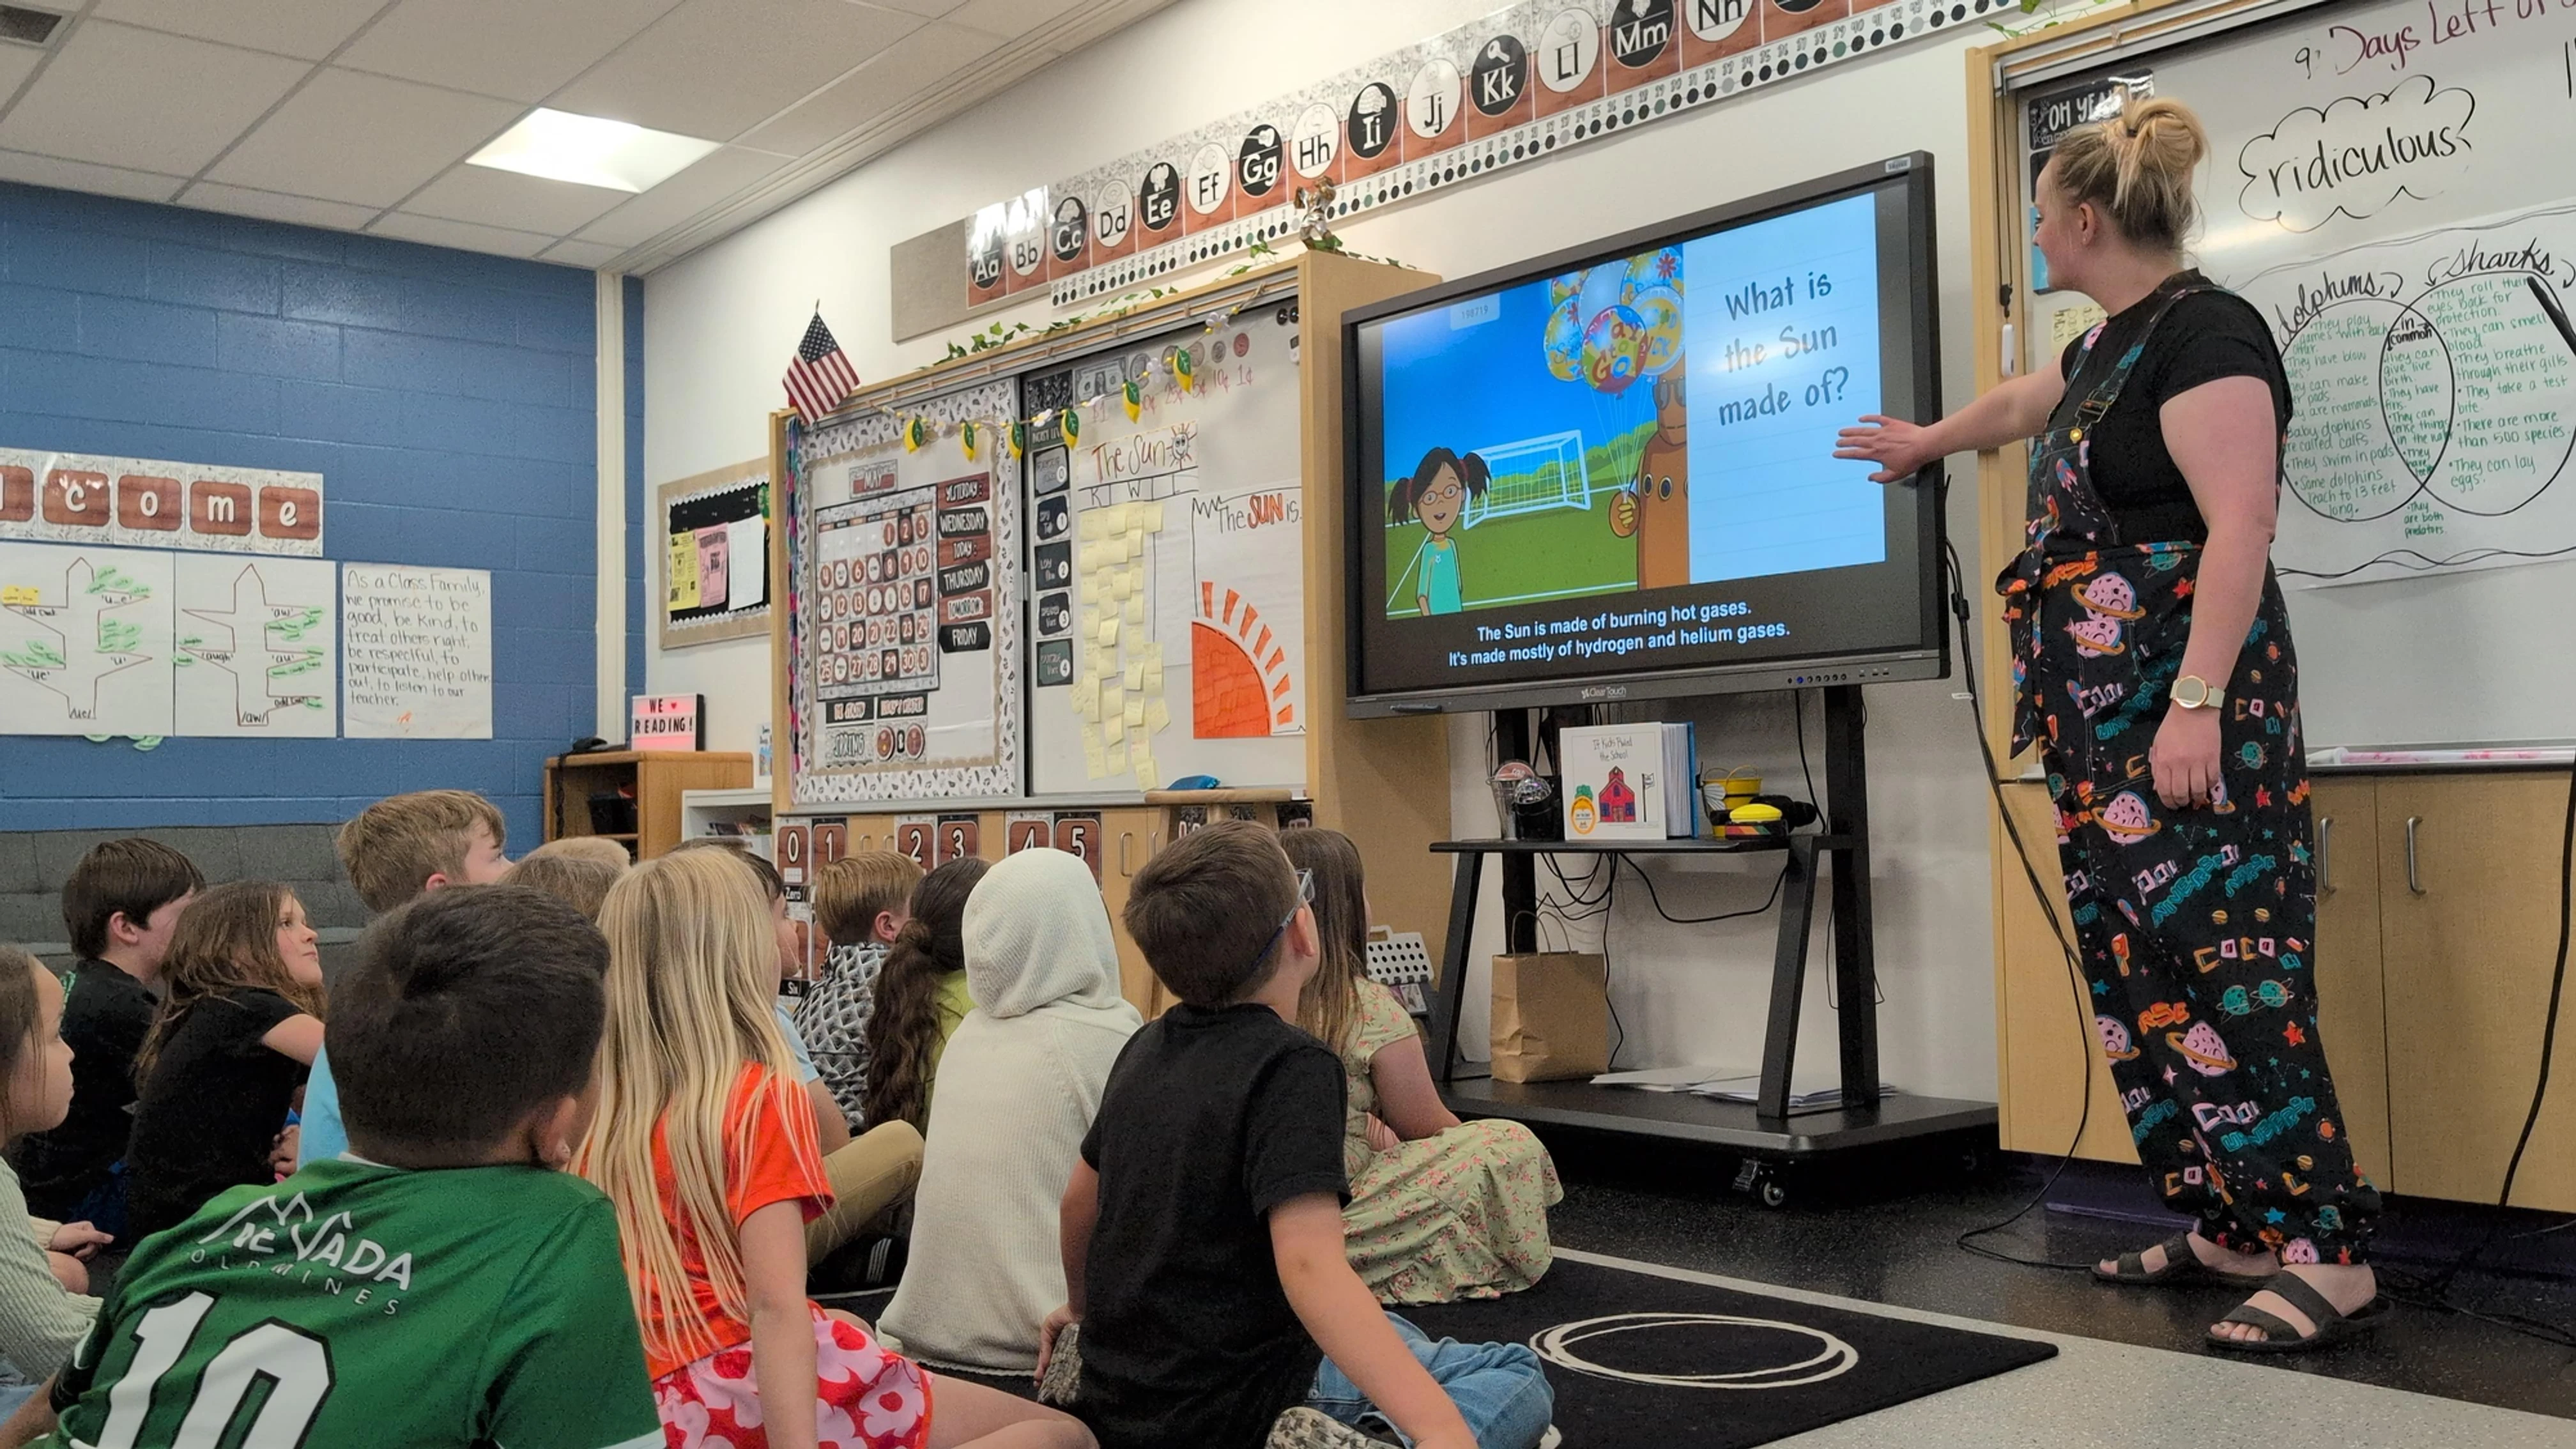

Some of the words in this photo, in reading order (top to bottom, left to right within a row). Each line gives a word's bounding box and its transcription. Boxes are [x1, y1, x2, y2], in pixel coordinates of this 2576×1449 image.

[2329, 25, 2421, 76] Days
[2048, 100, 2071, 131] OH
[975, 258, 999, 282] Aa
[1016, 241, 1038, 268] Bb
[1056, 226, 1082, 252] Cc
[1100, 206, 1126, 239] Dd
[1147, 194, 1172, 224] Ee
[1199, 171, 1220, 205] Ff
[1243, 154, 1277, 187] Gg
[1299, 136, 1331, 170] Hh
[1363, 117, 1383, 150] Ii
[1424, 95, 1443, 134] Jj
[1483, 66, 1516, 105] Kk
[1557, 42, 1580, 80] Ll
[1616, 21, 1667, 57] Mm
[2267, 125, 2458, 197] ridiculous
[1724, 275, 1795, 323] What
[1809, 271, 1833, 301] is
[2401, 318, 2415, 331] in
[1724, 337, 1767, 374] the
[1777, 323, 1838, 360] Sun
[1719, 383, 1791, 425] made
[1805, 366, 1849, 407] of?
[2529, 381, 2536, 390] a
[2493, 431, 2520, 444] 500
[1092, 443, 1124, 484] The
[1128, 435, 1166, 475] Sun
[1091, 488, 1101, 507] K
[1128, 480, 1141, 498] W
[940, 511, 985, 532] WEDNESDAY
[1219, 505, 1246, 535] The
[1248, 493, 1284, 529] SUN
[902, 523, 909, 539] 2
[919, 518, 926, 535] 3
[348, 569, 369, 588] As
[374, 579, 384, 589] a
[388, 572, 427, 590] Class
[854, 563, 861, 581] 6
[944, 565, 984, 591] THURSDAY
[346, 594, 362, 606] we
[369, 595, 422, 610] promise
[424, 594, 443, 611] to
[450, 595, 470, 611] be
[394, 610, 412, 627] be
[460, 615, 479, 633] to
[852, 627, 864, 645] 20
[902, 621, 914, 638] 23
[1477, 626, 1501, 643] The
[1505, 622, 1531, 640] Sun
[1535, 620, 1545, 636] is
[1550, 617, 1588, 636] made
[1591, 613, 1607, 631] of
[1610, 608, 1666, 629] burning
[1671, 604, 1697, 623] hot
[1700, 601, 1752, 621] gases.
[346, 628, 385, 644] treat
[390, 629, 431, 645] others
[952, 627, 978, 647] FRIDAY
[1449, 651, 1467, 666] It's
[1471, 647, 1506, 664] made
[1510, 643, 1554, 663] mostly
[1558, 640, 1574, 657] of
[1575, 635, 1644, 656] hydrogen
[1647, 631, 1676, 648] and
[1681, 626, 1733, 644] helium
[1736, 621, 1791, 643] gases.
[348, 642, 363, 658] be
[441, 650, 460, 666] to
[903, 654, 914, 670] 30
[377, 678, 390, 692] to
[395, 679, 427, 695] listen
[433, 684, 445, 697] to
[426, 668, 455, 684] help
[649, 698, 663, 714] WE
[634, 717, 693, 734] READING!
[788, 830, 799, 863] 0
[825, 831, 833, 863] 1
[909, 829, 922, 863] 2
[952, 828, 965, 861] 3
[1070, 827, 1085, 859] 5
[785, 886, 801, 901] Zero
[93, 1291, 332, 1449] 10
